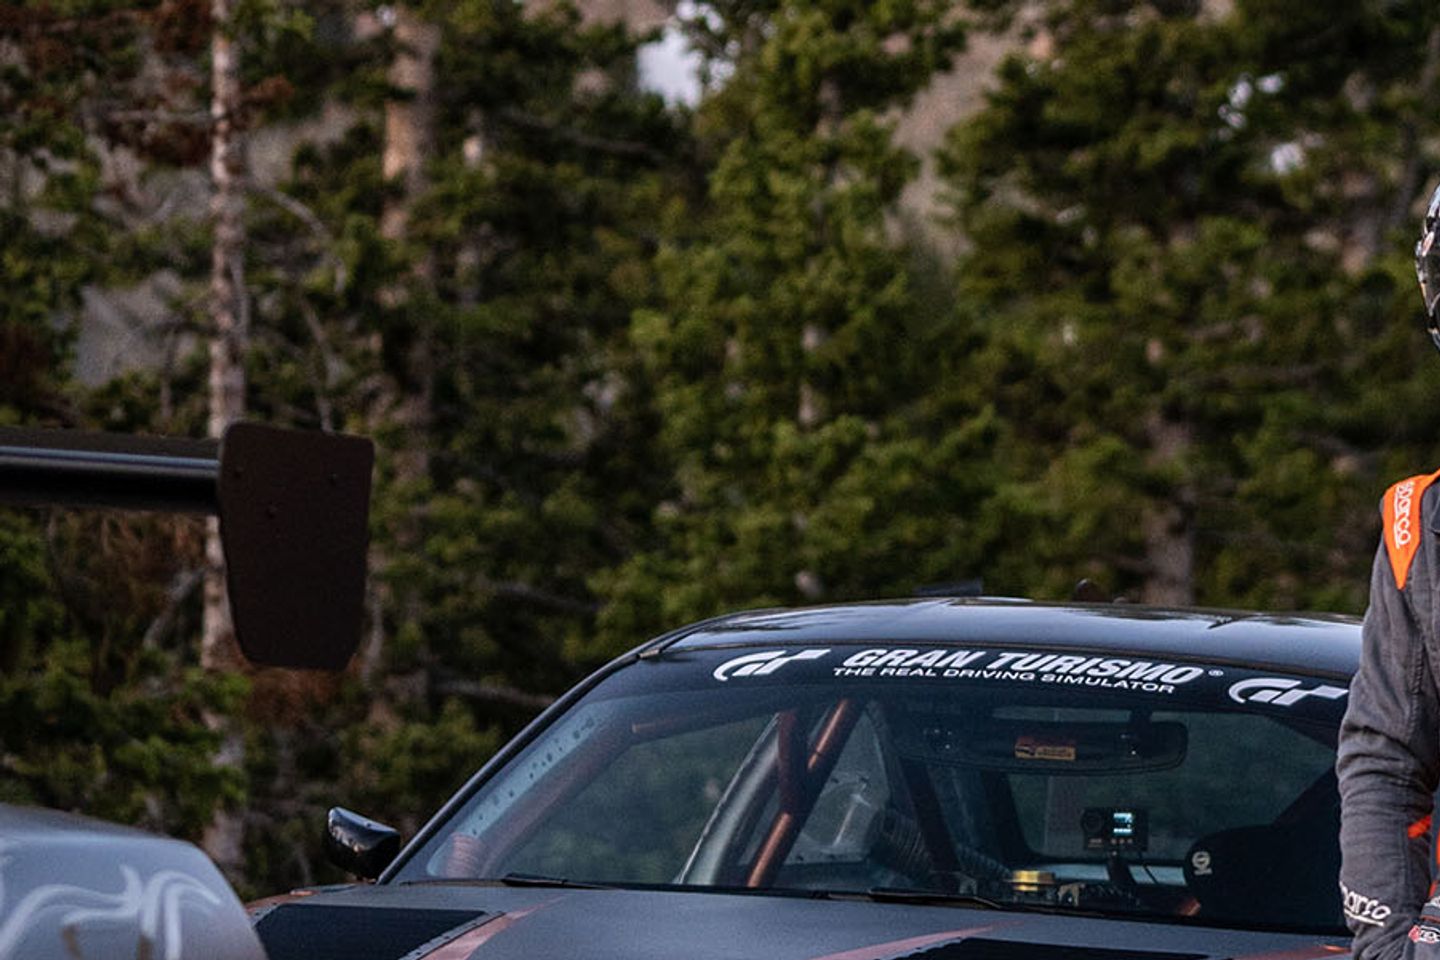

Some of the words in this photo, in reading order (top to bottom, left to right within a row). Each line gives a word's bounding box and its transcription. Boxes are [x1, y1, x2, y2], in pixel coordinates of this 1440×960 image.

[833, 667, 876, 676] THE
[879, 668, 937, 678] REAL
[942, 668, 1035, 681] DRIVING
[1040, 672, 1175, 694] SIMULATOR
[842, 649, 987, 668] GRAN
[986, 651, 1204, 684] TURISMO
